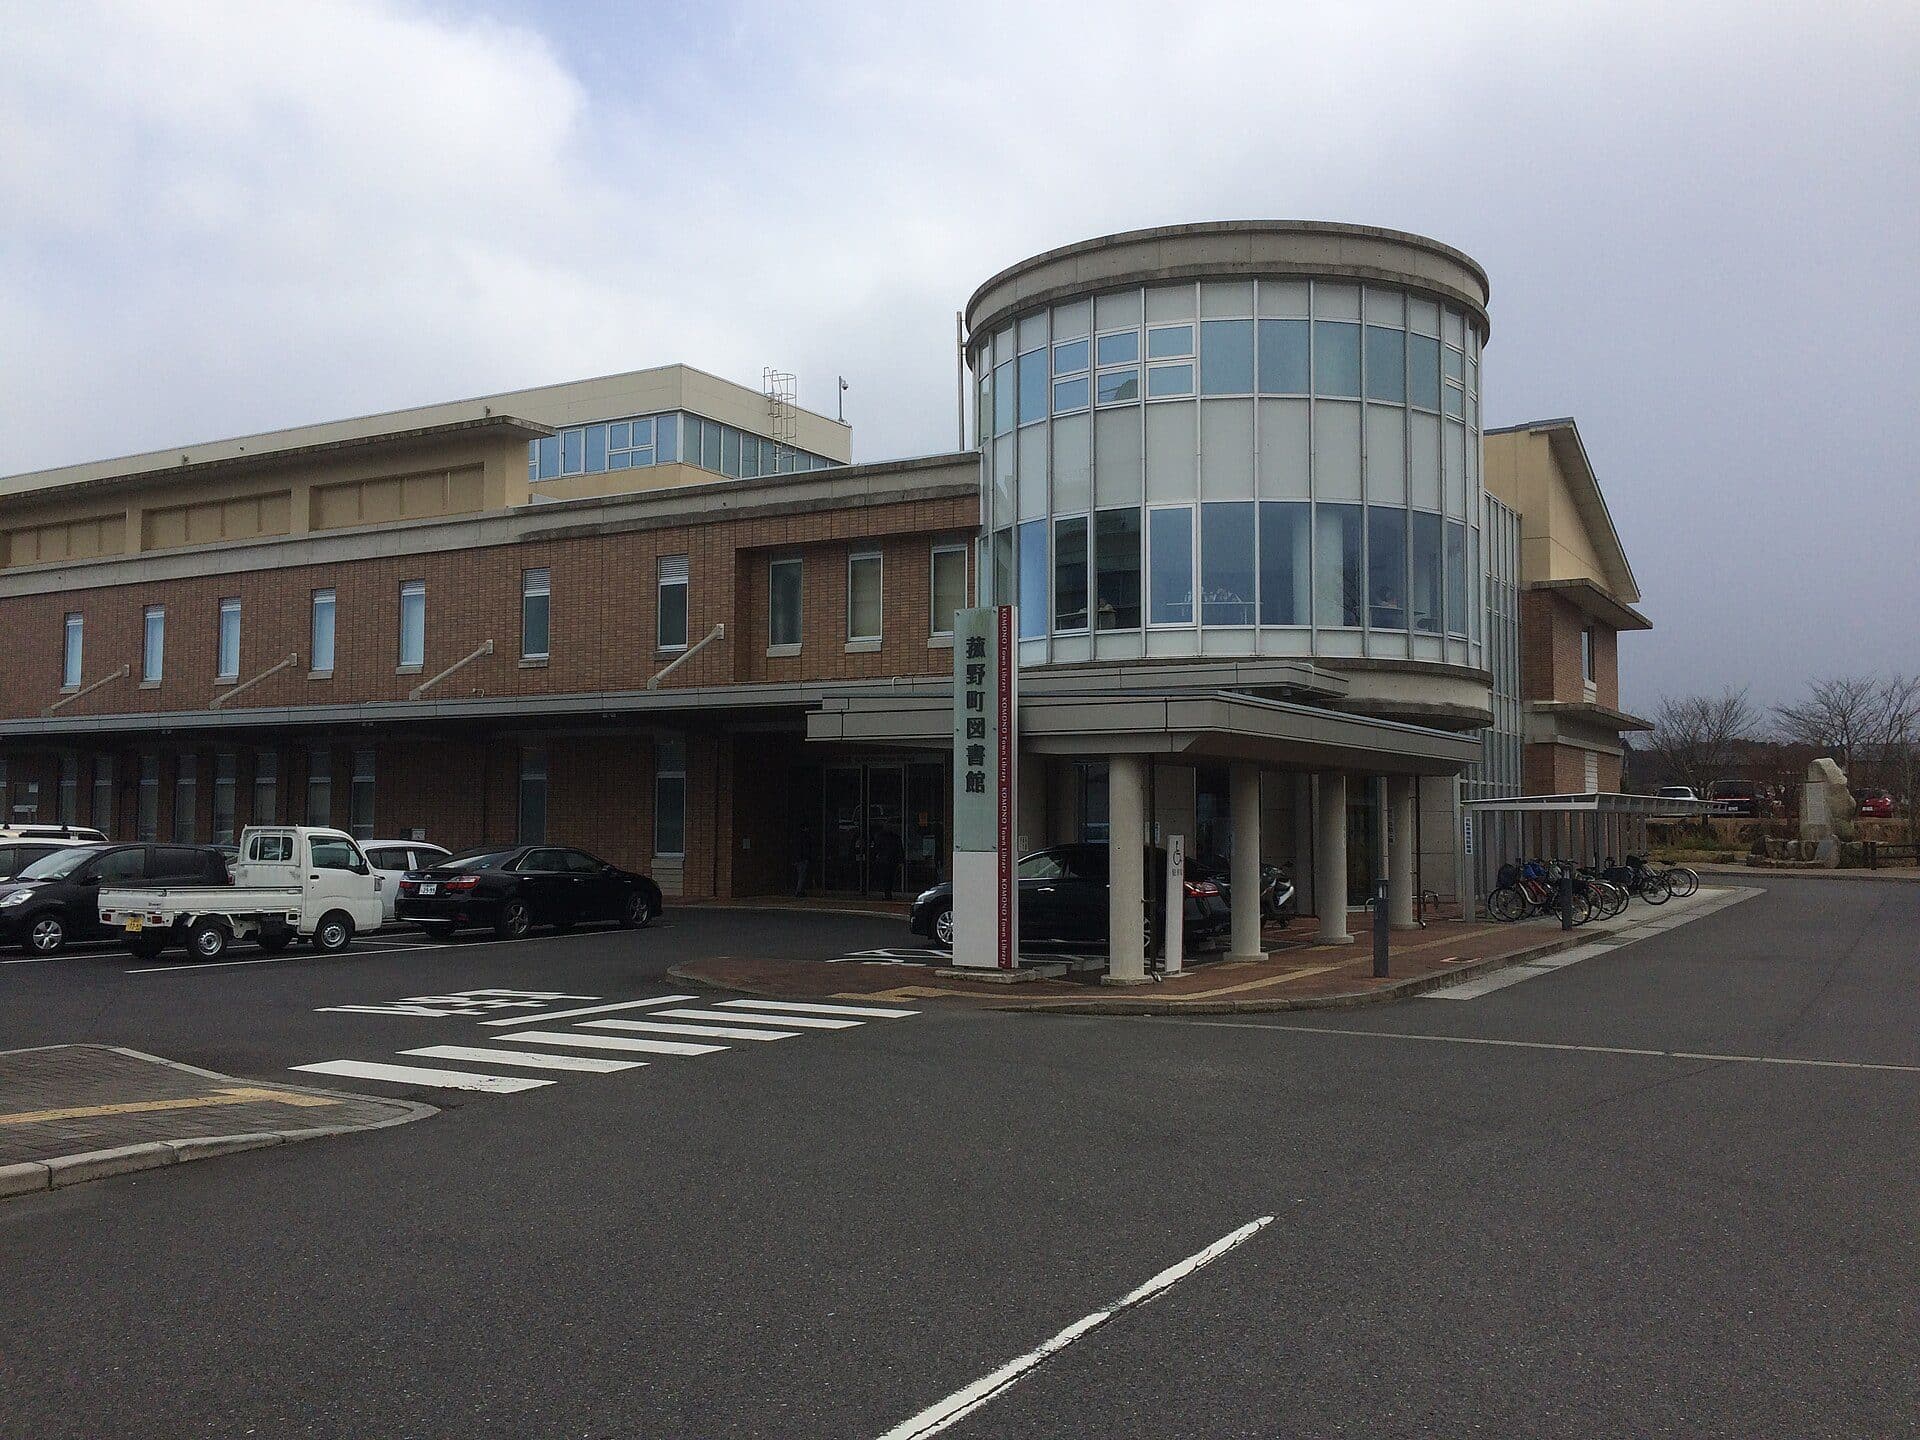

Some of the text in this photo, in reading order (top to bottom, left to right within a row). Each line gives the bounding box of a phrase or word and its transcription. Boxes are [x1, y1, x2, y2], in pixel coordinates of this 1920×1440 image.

[966, 636, 986, 794] 菰野町図書館
